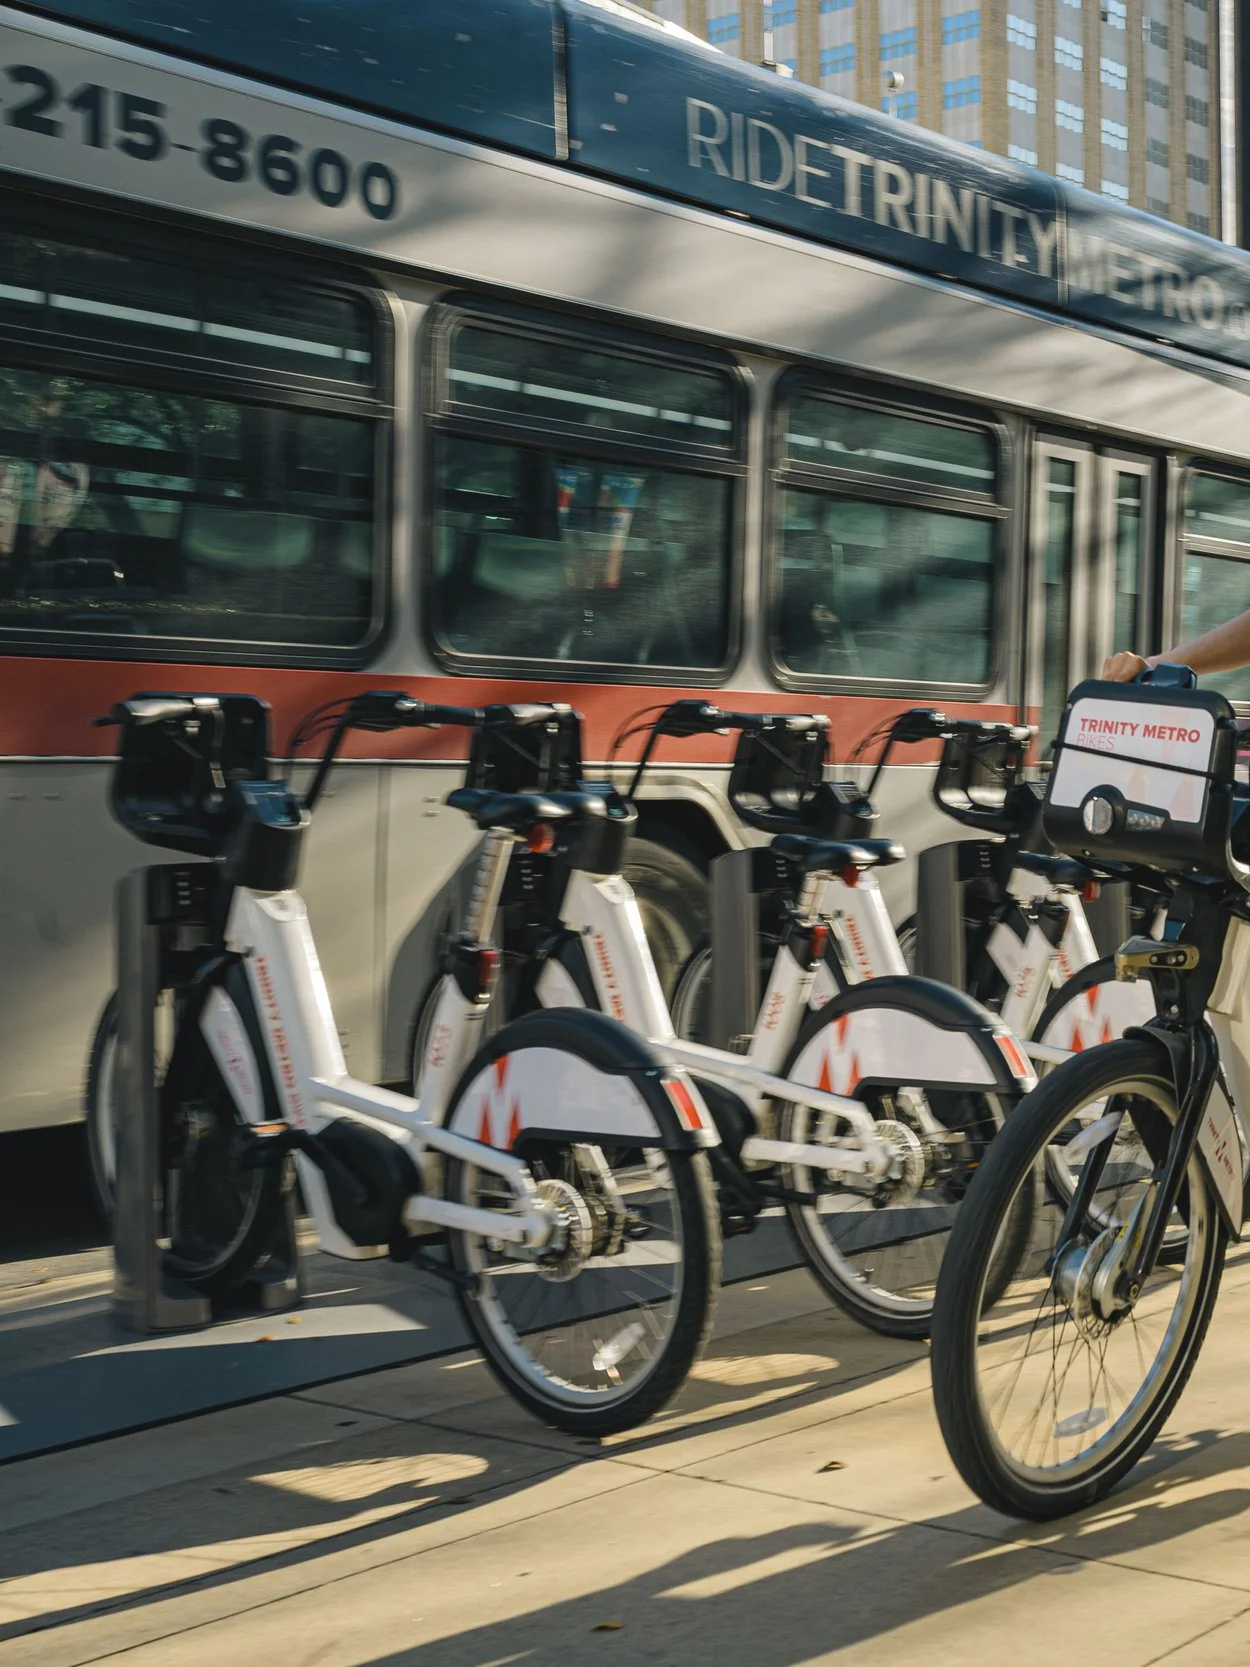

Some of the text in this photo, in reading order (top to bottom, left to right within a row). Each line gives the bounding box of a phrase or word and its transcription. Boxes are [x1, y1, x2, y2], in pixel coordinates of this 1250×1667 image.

[1080, 718, 1201, 743] TRINITY METRO
[1077, 733, 1116, 751] BIKES
